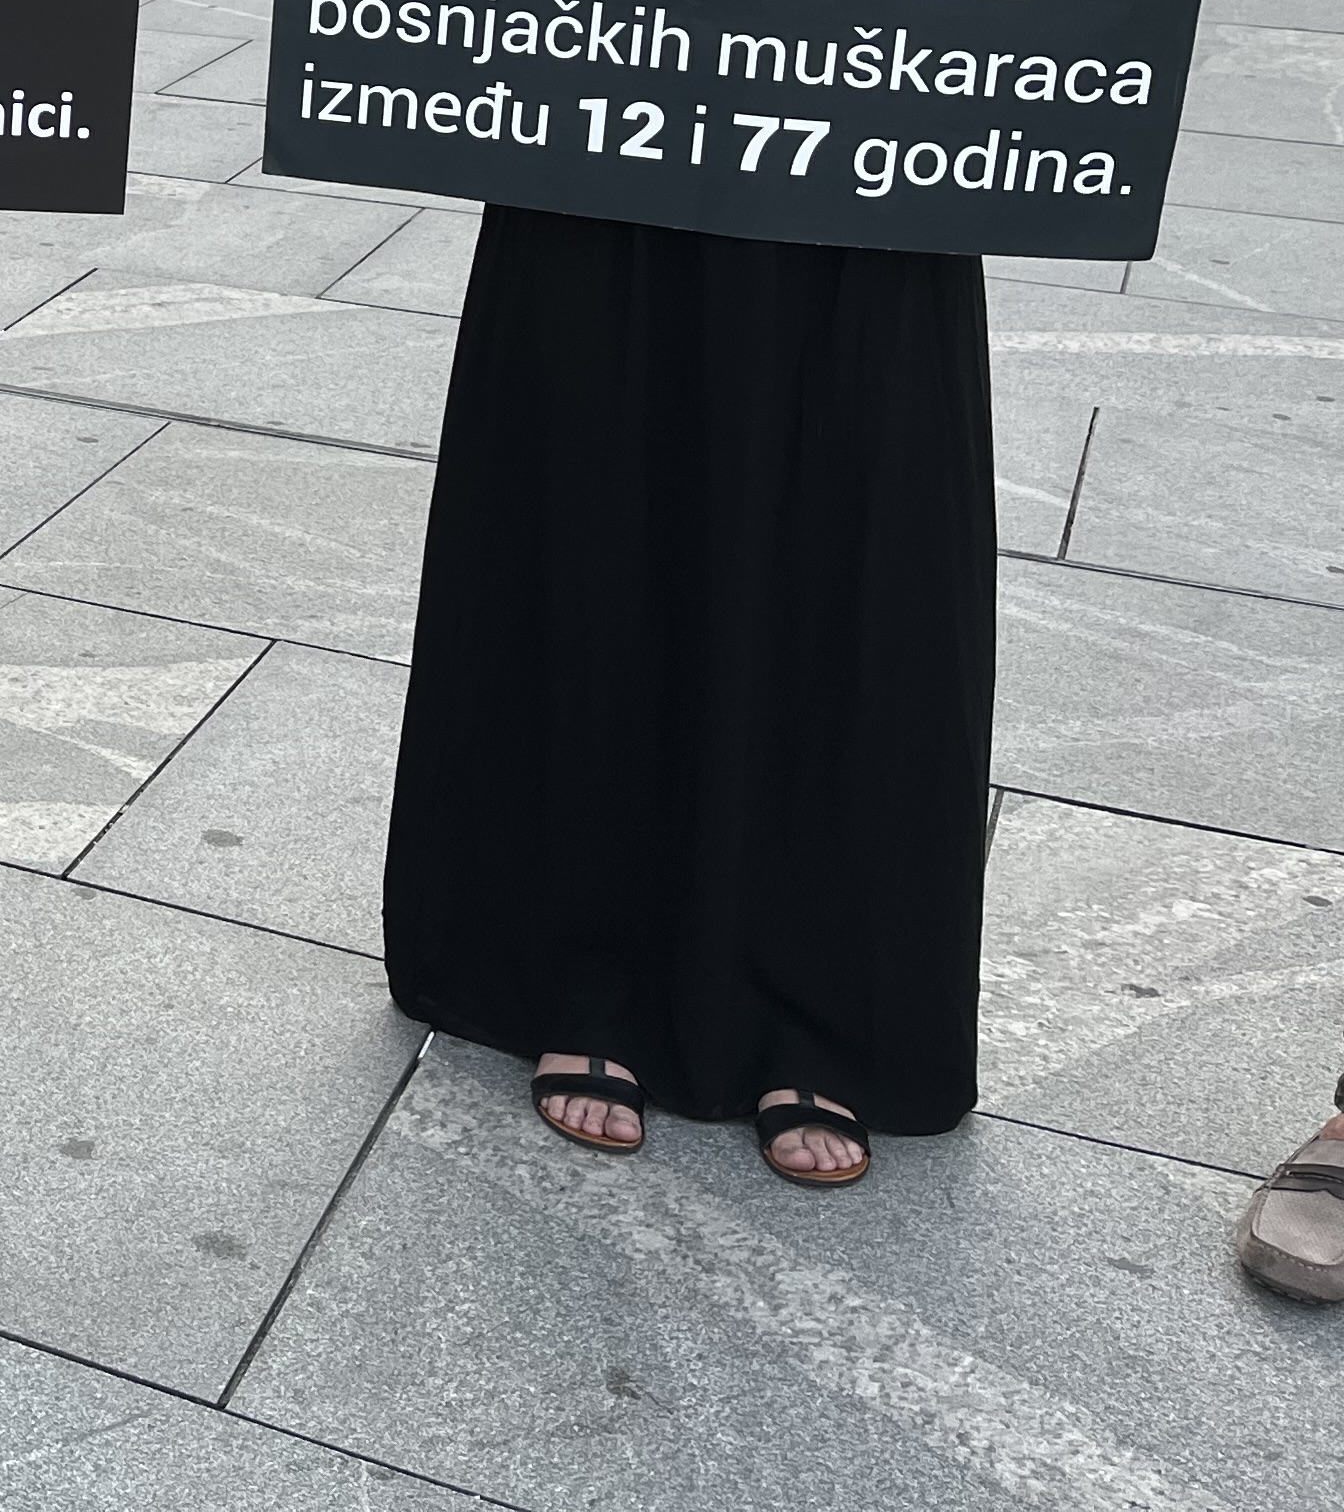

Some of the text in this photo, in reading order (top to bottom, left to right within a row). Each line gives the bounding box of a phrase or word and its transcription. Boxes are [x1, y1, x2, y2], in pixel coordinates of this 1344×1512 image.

[717, 26, 1152, 105] muškaraca
[301, 62, 1132, 198] između 12 i 77 godina.
